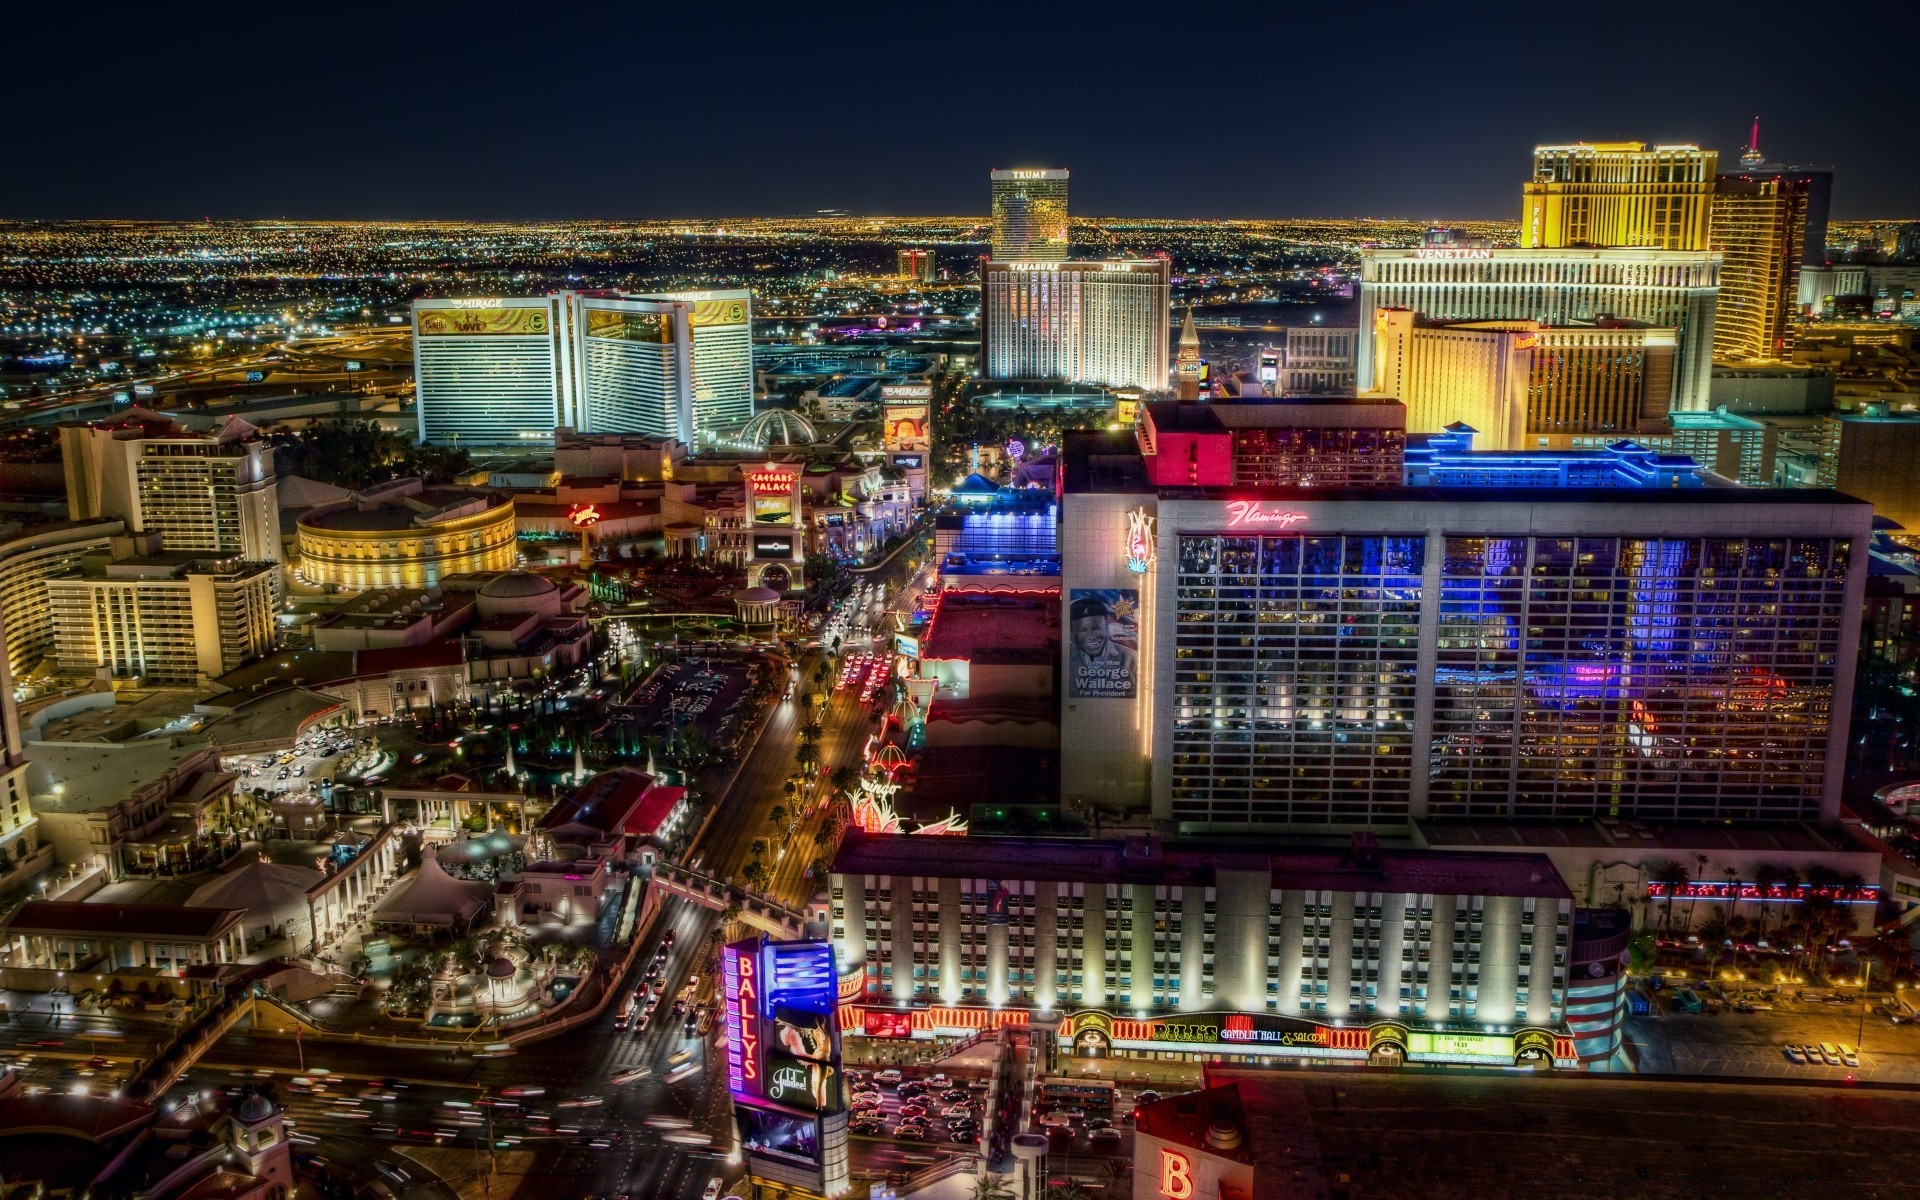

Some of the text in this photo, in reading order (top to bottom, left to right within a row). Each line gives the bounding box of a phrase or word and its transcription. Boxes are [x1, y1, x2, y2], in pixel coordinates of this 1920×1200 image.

[1013, 170, 1046, 179] TRUMP
[1416, 248, 1491, 259] VENETIAN
[1010, 262, 1131, 272] TREASURE ISLAND
[675, 291, 712, 302] MIRAGE
[459, 299, 503, 309] MIRAGE
[458, 322, 482, 332] LOVE
[887, 387, 930, 397] MIRAGE
[751, 474, 792, 482] CAESARS
[753, 483, 791, 491] PALACE
[1226, 500, 1308, 528] Flamingo
[1077, 665, 1130, 679] George
[1074, 678, 1132, 689] Wallace
[739, 956, 757, 1079] BALLYS
[1153, 1024, 1218, 1043] BILL'S
[1260, 1031, 1282, 1041] HALL
[1291, 1033, 1327, 1043] SALOON
[1160, 1149, 1193, 1200] B
